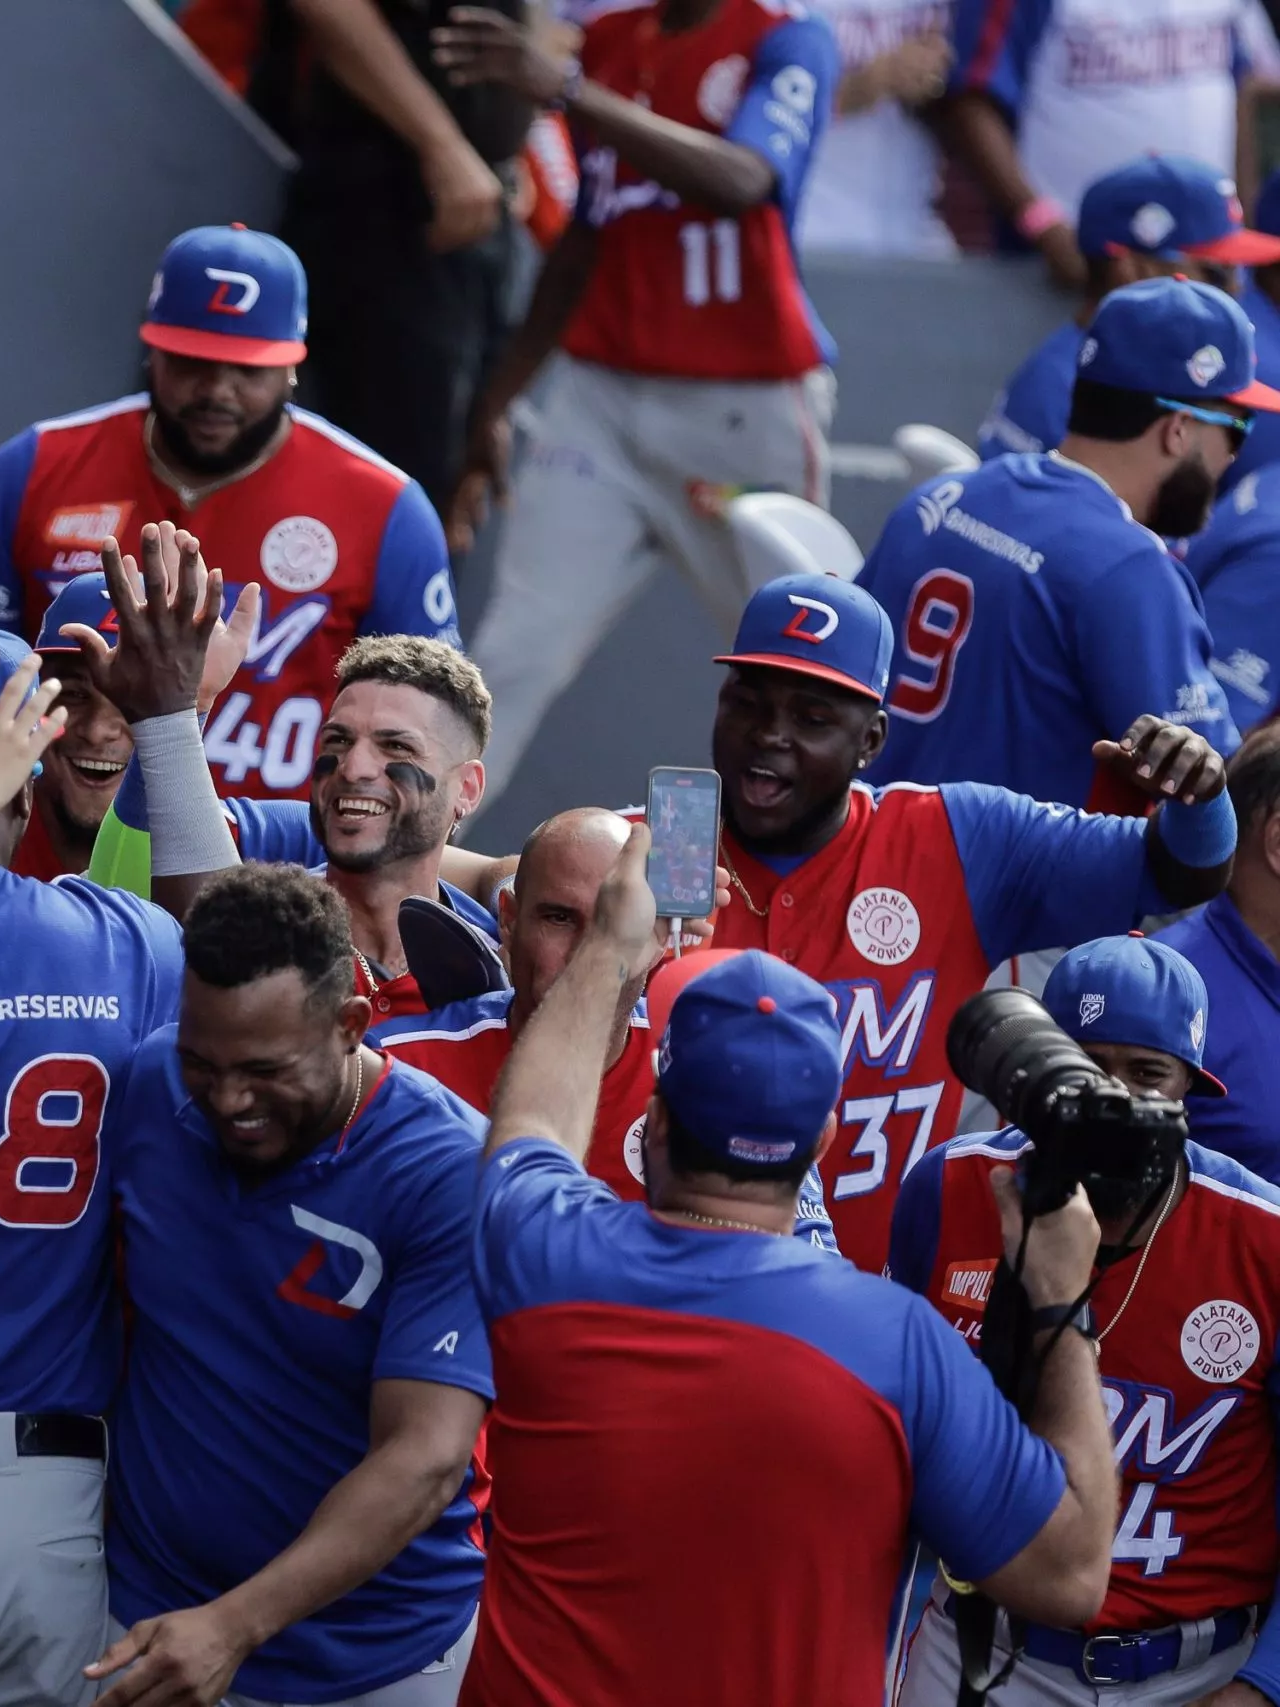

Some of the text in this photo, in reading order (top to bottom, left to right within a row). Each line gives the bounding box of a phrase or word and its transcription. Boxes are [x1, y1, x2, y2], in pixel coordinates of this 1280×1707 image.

[679, 219, 741, 306] 11
[888, 567, 974, 724] 9
[203, 691, 322, 789] 40
[867, 937, 912, 960] POWER
[834, 1081, 946, 1199] 37
[949, 1270, 993, 1302] IMPUL
[1193, 1357, 1243, 1379] POWER
[1111, 1482, 1182, 1576] 4
